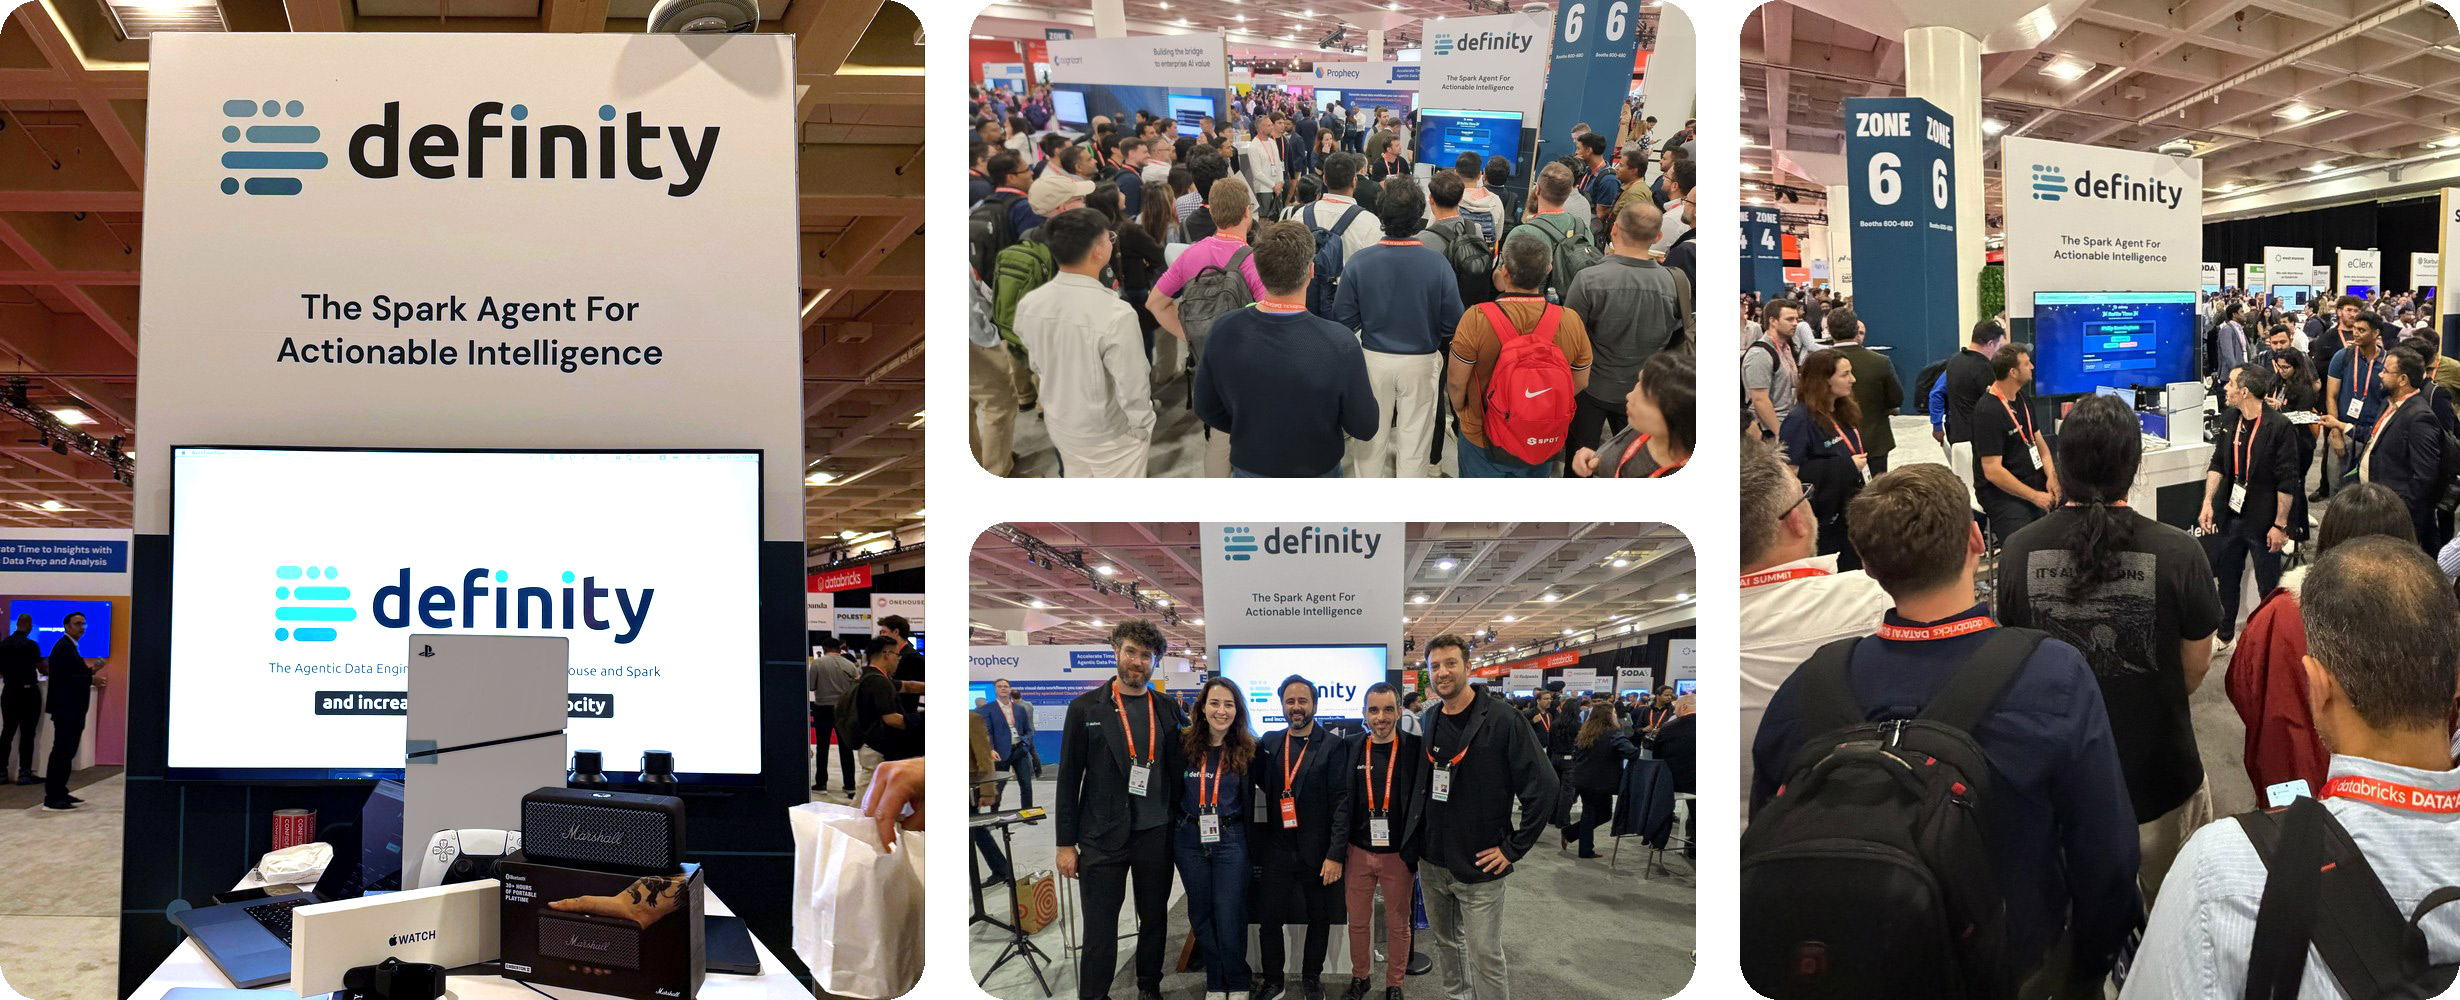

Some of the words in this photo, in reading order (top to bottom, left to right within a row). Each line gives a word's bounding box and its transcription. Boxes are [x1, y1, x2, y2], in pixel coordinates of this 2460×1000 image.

[1564, 3, 1585, 43] 6
[1606, 1, 1629, 41] 6
[1457, 31, 1533, 53] definity
[1153, 48, 1174, 57] Building
[1175, 47, 1184, 55] the
[1185, 47, 1203, 56] bridge
[1327, 69, 1359, 79] Prophecy
[1476, 84, 1514, 92] Intelligence
[1856, 112, 1911, 137] ZONE
[1926, 115, 1951, 149] ZONE
[348, 101, 721, 197] definity
[1868, 152, 1902, 206] 6
[1932, 158, 1948, 210] 6
[2074, 170, 2183, 210] definity
[1756, 211, 1778, 224] ZONE
[1860, 220, 1882, 228] Booths
[1883, 220, 1914, 228] 600-680
[1761, 228, 1775, 250] 4
[2061, 235, 2081, 245] The
[2083, 236, 2113, 248] Spark
[2115, 238, 2143, 249] Agent
[2146, 239, 2161, 249] For
[2053, 250, 2110, 261] Actionable
[2112, 252, 2167, 263] Intelligence
[2347, 258, 2374, 269] eClerx
[301, 294, 362, 322] The
[372, 295, 467, 328] Spark
[476, 296, 575, 329] Agent
[586, 297, 640, 322] For
[276, 337, 458, 366] Actionable
[468, 340, 663, 373] Intelligence
[1538, 436, 1559, 444] SPOT
[18, 545, 40, 553] Time
[54, 546, 90, 555] Insights
[92, 546, 112, 554] with
[1264, 526, 1381, 559] definity
[3, 557, 24, 565] Data
[26, 557, 47, 566] Prep
[50, 557, 67, 565] and
[69, 558, 107, 567] Analysis
[825, 571, 861, 589] databricks
[1753, 571, 1793, 585] SUMMIT
[2036, 567, 2057, 579] IT'S
[372, 567, 655, 644] definity
[1252, 593, 1271, 602] The
[1273, 593, 1303, 604] Spark
[1306, 592, 1336, 602] Agent
[1339, 592, 1355, 601] For
[1245, 607, 1300, 616] Actionable
[1303, 607, 1362, 618] Intelligence
[1932, 619, 1983, 637] databricks
[269, 662, 292, 674] The
[295, 662, 342, 678] Agentic
[345, 662, 374, 675] Data
[568, 668, 597, 677] ouse
[600, 665, 622, 677] and
[625, 665, 661, 679] Spark
[322, 694, 353, 710] and
[358, 694, 407, 710] increa
[568, 699, 606, 714] ocity
[2336, 778, 2407, 804] databricks
[561, 824, 625, 845] Marshall
[513, 890, 537, 898] PORTABLE
[399, 930, 436, 945] WATCH
[565, 935, 611, 950] Marshall
[655, 987, 680, 997] Marshall
